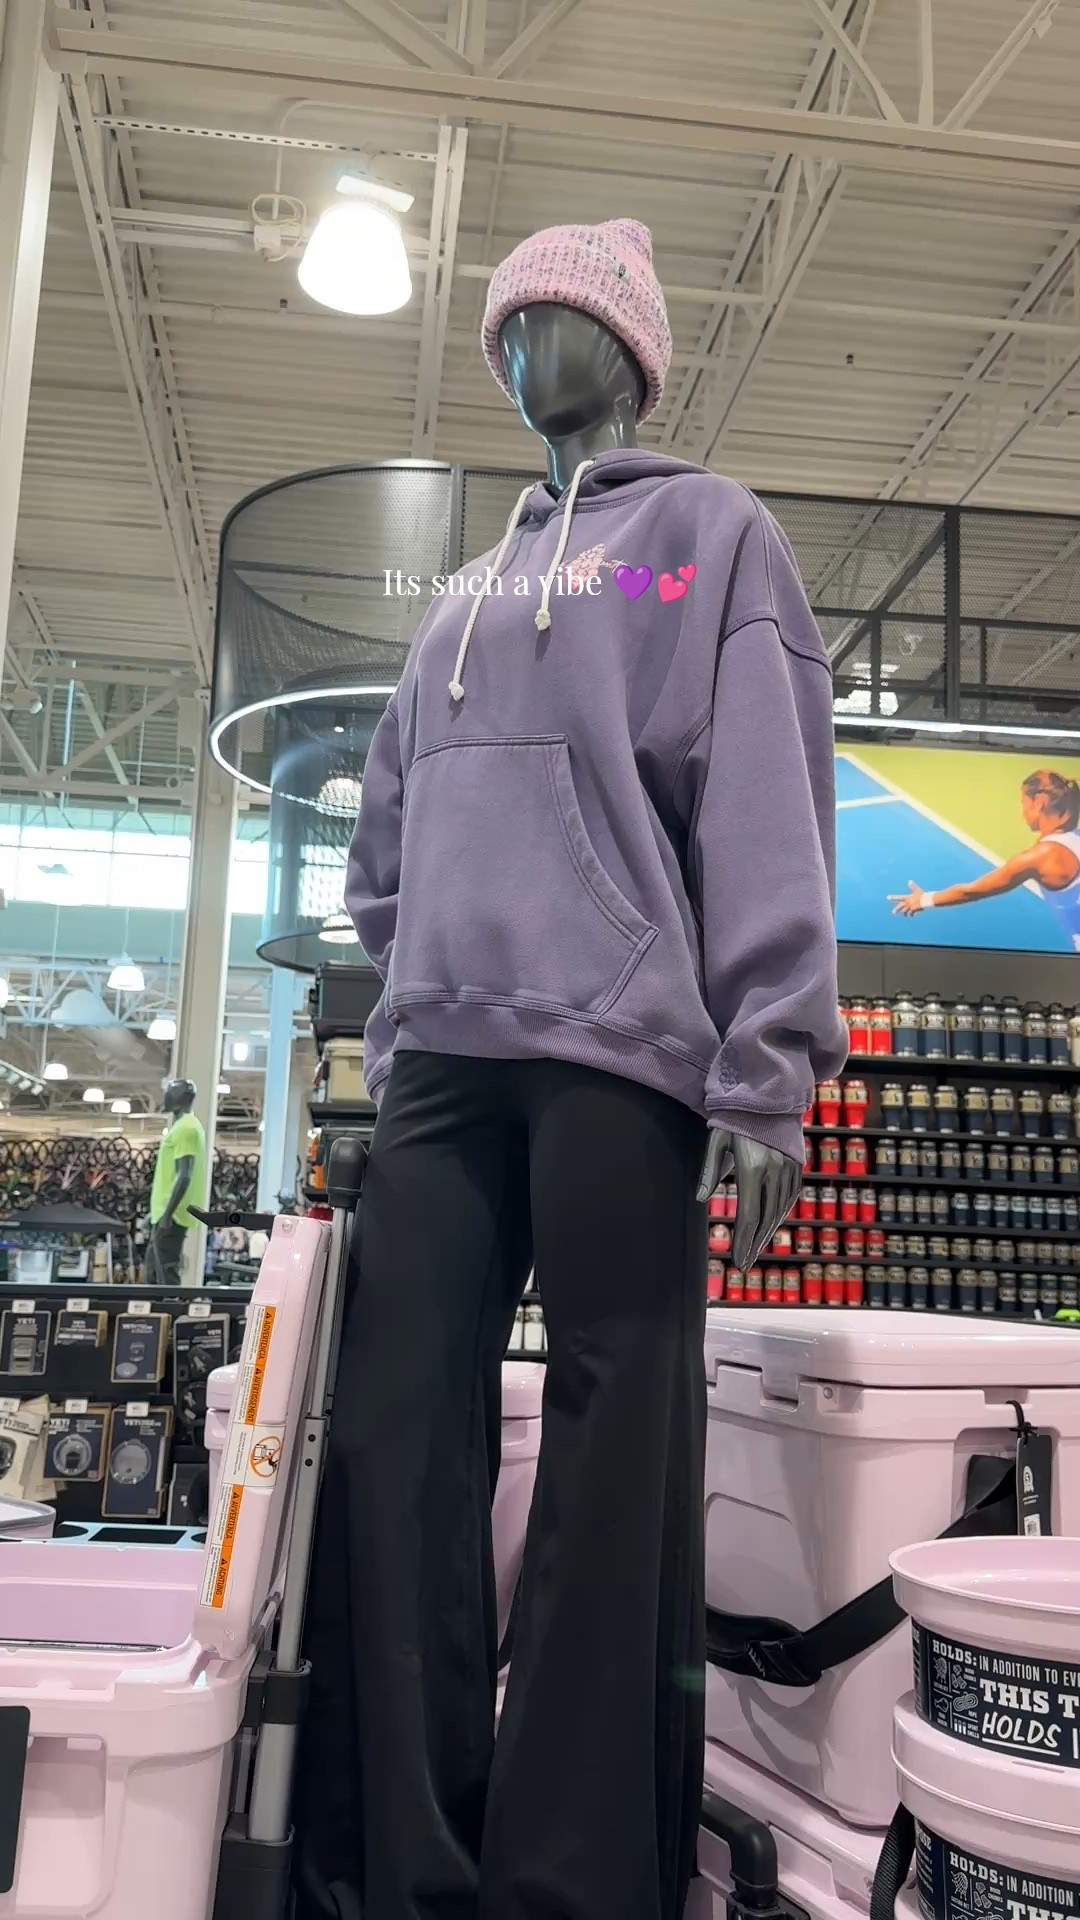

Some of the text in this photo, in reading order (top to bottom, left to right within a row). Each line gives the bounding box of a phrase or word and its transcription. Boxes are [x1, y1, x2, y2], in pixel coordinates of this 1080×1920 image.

[247, 1375, 262, 1423] AVERTISSEMENT
[215, 1566, 227, 1596] ACHTUNG
[932, 1639, 977, 1666] HOLDS:
[979, 1655, 990, 1672] IN
[992, 1658, 1041, 1682] ADDITION
[1044, 1667, 1058, 1685] TO
[979, 1678, 1050, 1714] THIS
[981, 1711, 1062, 1749] HOLDS
[949, 1851, 1004, 1886] HOLDS:
[1006, 1874, 1018, 1893] IN
[1021, 1879, 1074, 1908] ADDITION
[1006, 1899, 1080, 1920] TH
